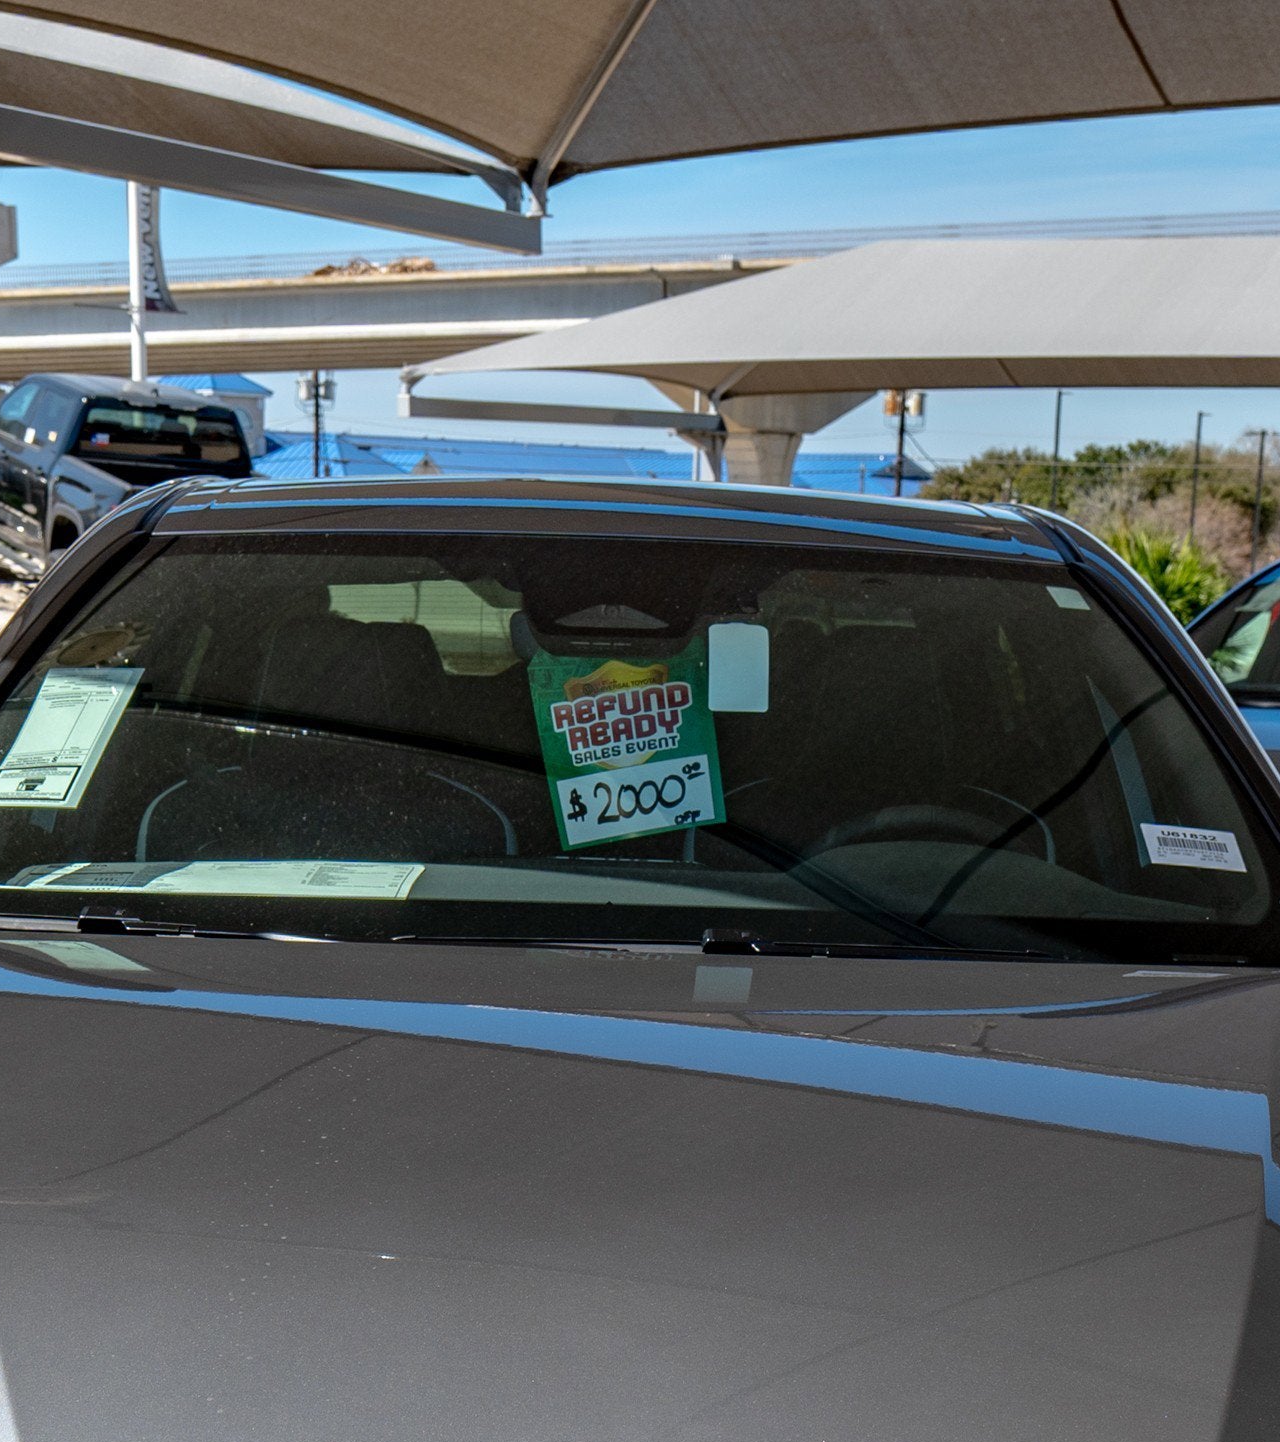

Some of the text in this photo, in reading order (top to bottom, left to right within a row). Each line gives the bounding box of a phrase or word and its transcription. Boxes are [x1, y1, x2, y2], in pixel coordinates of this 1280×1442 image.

[553, 683, 690, 730] REFUND
[568, 709, 680, 751] READY
[574, 735, 679, 764] SALES EVENT
